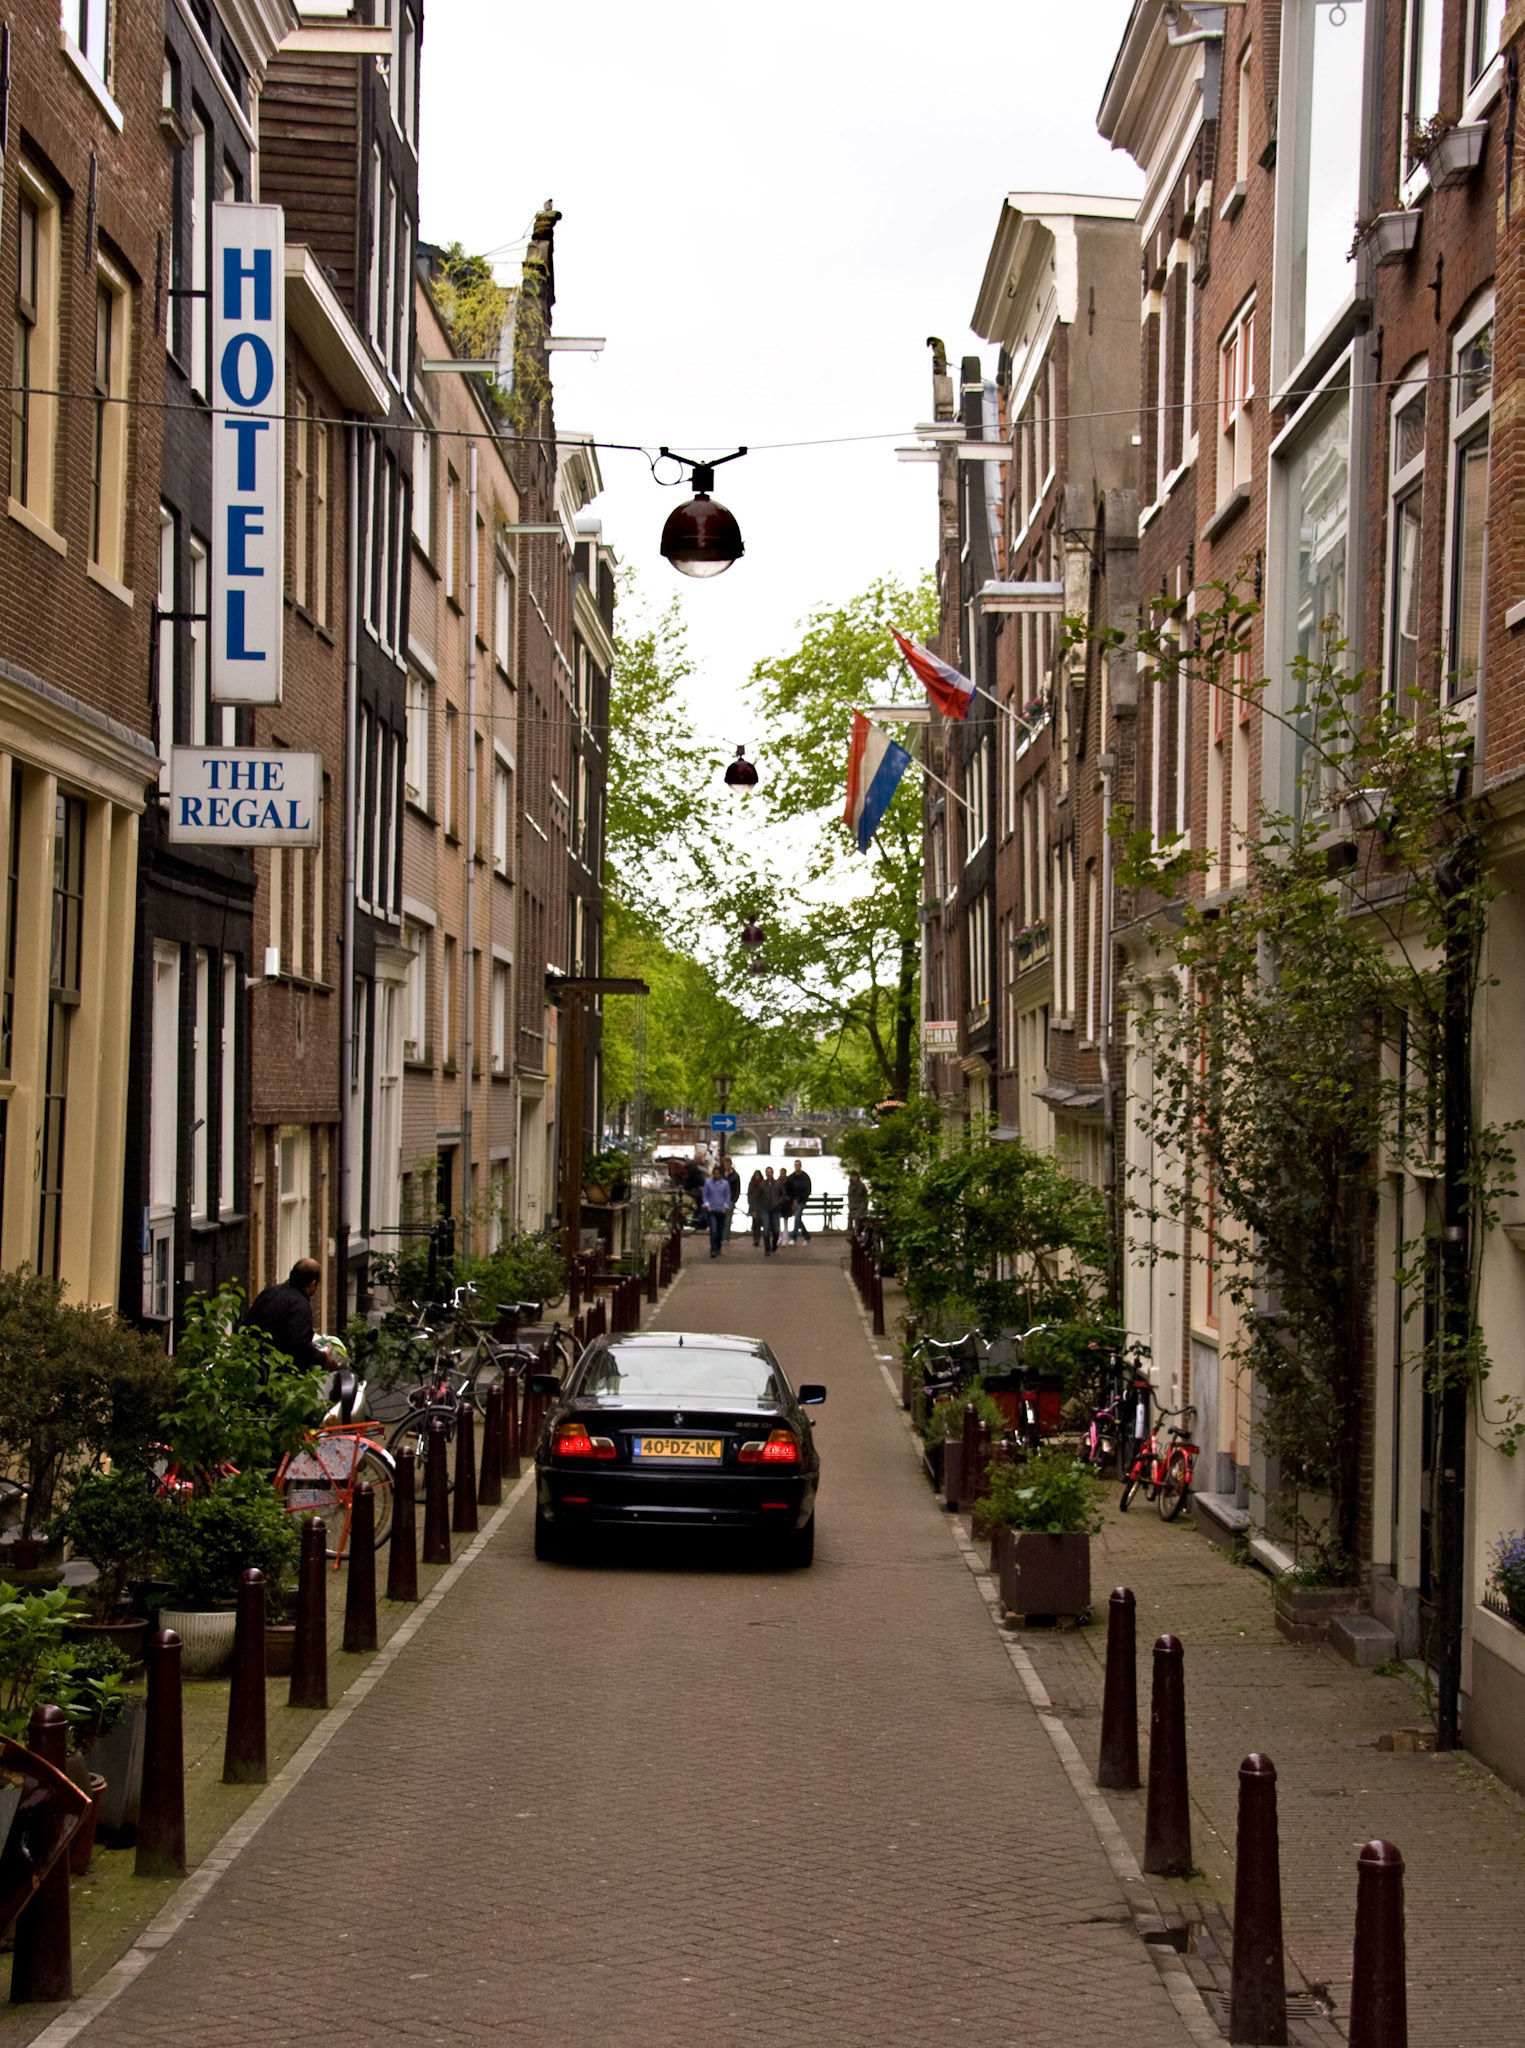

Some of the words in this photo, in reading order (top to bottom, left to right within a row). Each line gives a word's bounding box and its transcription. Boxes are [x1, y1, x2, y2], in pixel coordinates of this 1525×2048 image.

[221, 248, 274, 661] HOTEL
[203, 760, 284, 791] THE
[178, 796, 310, 830] REGAL
[643, 1439, 716, 1455] 40-DZ-NK
